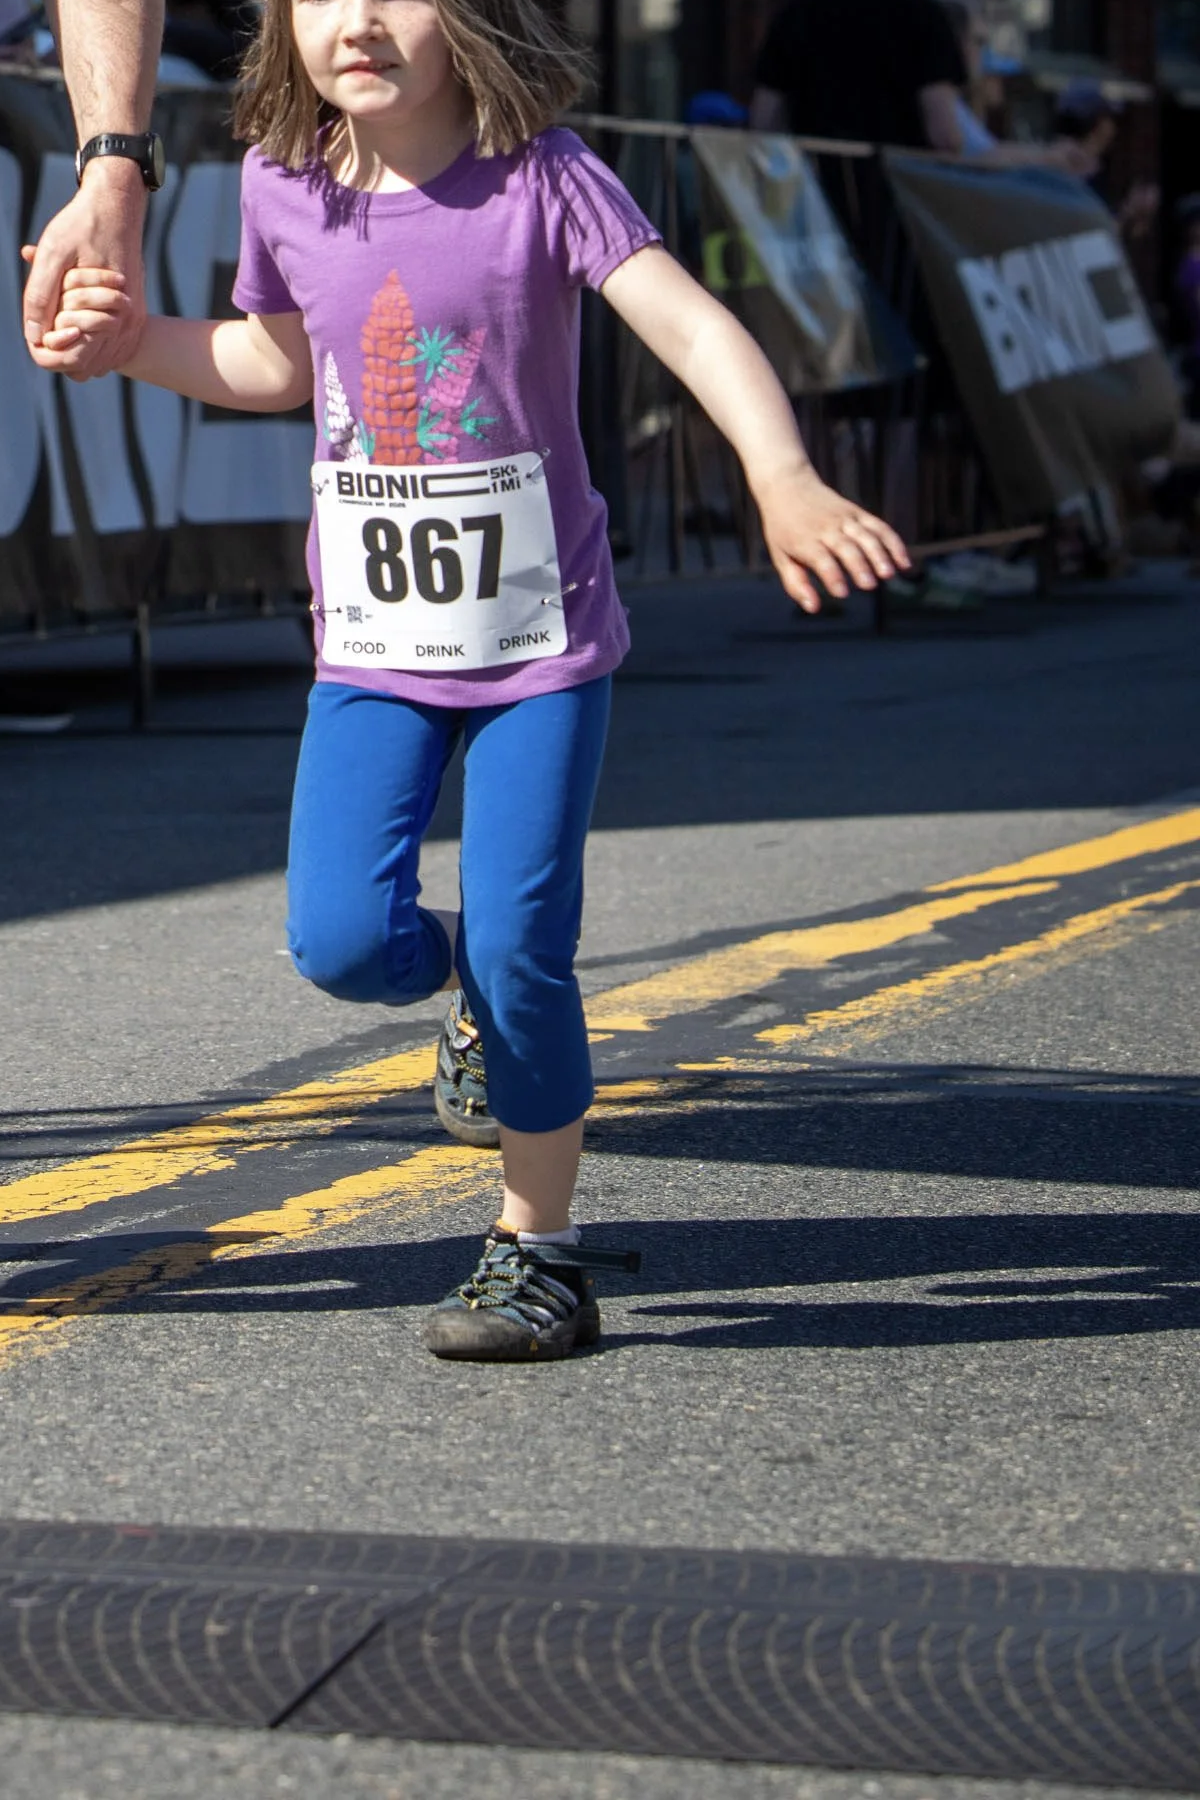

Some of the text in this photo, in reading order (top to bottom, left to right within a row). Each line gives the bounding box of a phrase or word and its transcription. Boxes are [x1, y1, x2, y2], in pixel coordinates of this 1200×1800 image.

[336, 469, 490, 499] BIONIC
[362, 513, 503, 604] 867
[343, 630, 551, 657] FOOD DRINK DRINK
